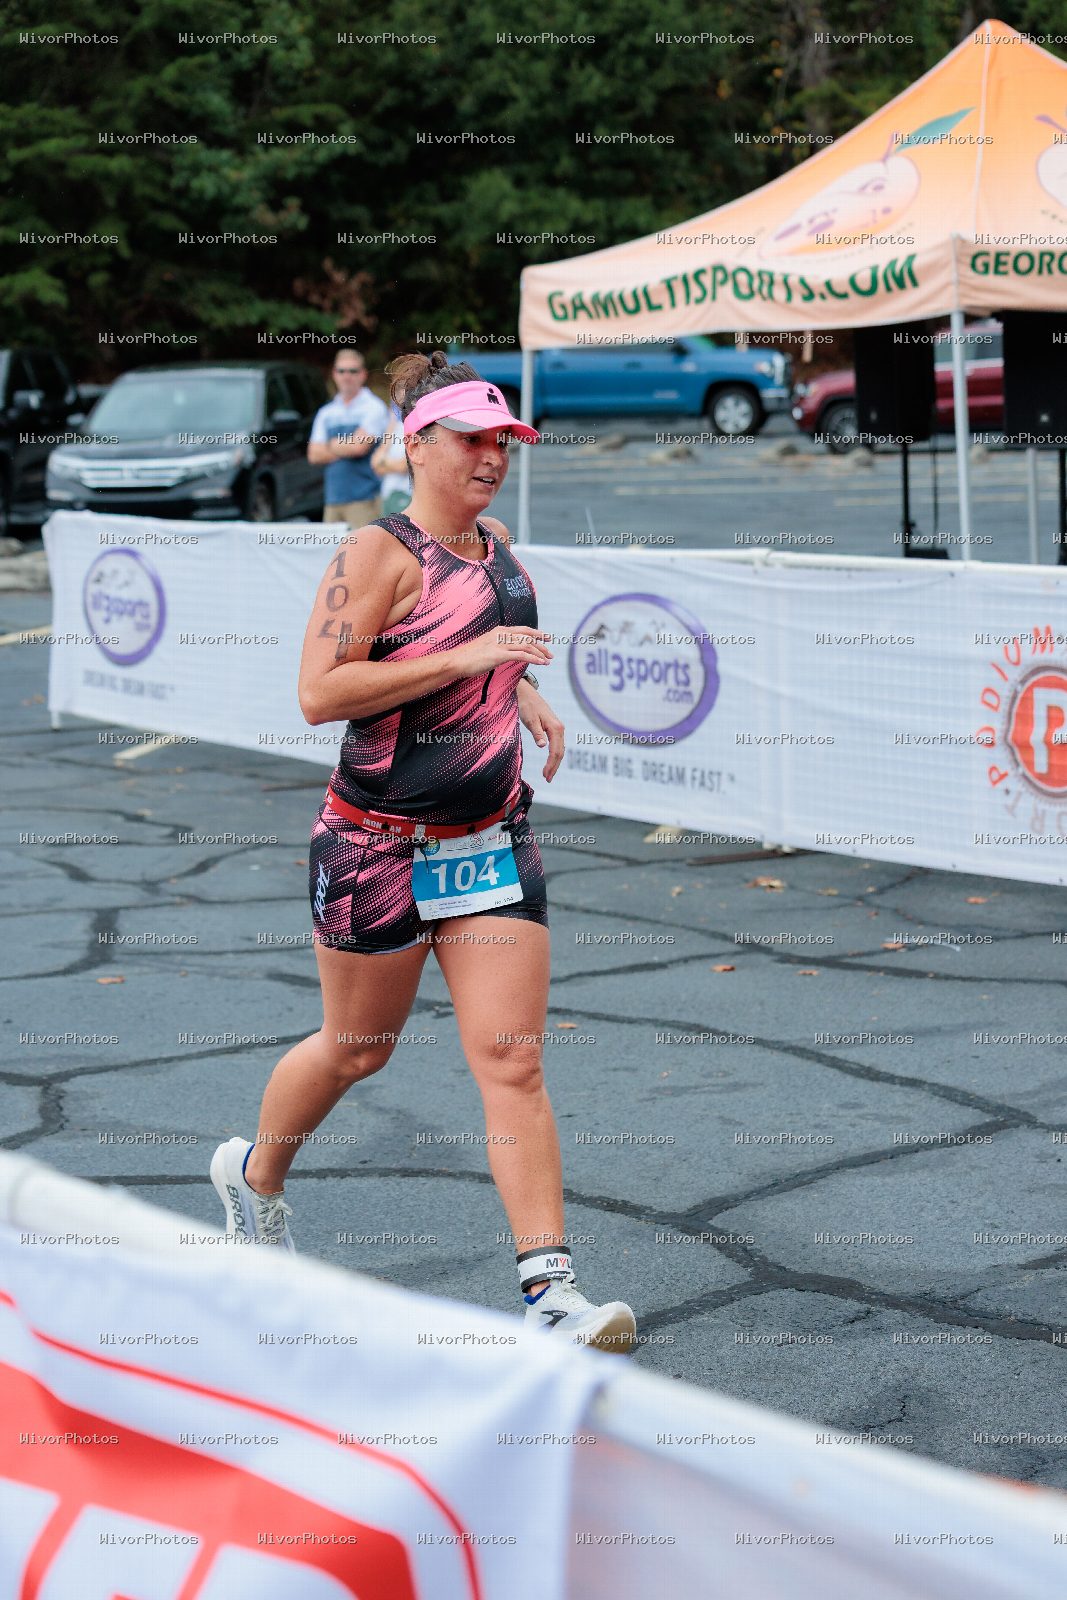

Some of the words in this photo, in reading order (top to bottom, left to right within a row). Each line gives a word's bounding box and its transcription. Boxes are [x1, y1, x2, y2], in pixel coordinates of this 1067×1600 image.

[585, 648, 692, 692] all3sports
[566, 750, 609, 774] DREAM
[641, 760, 687, 788] DREAM
[431, 854, 500, 894] 104
